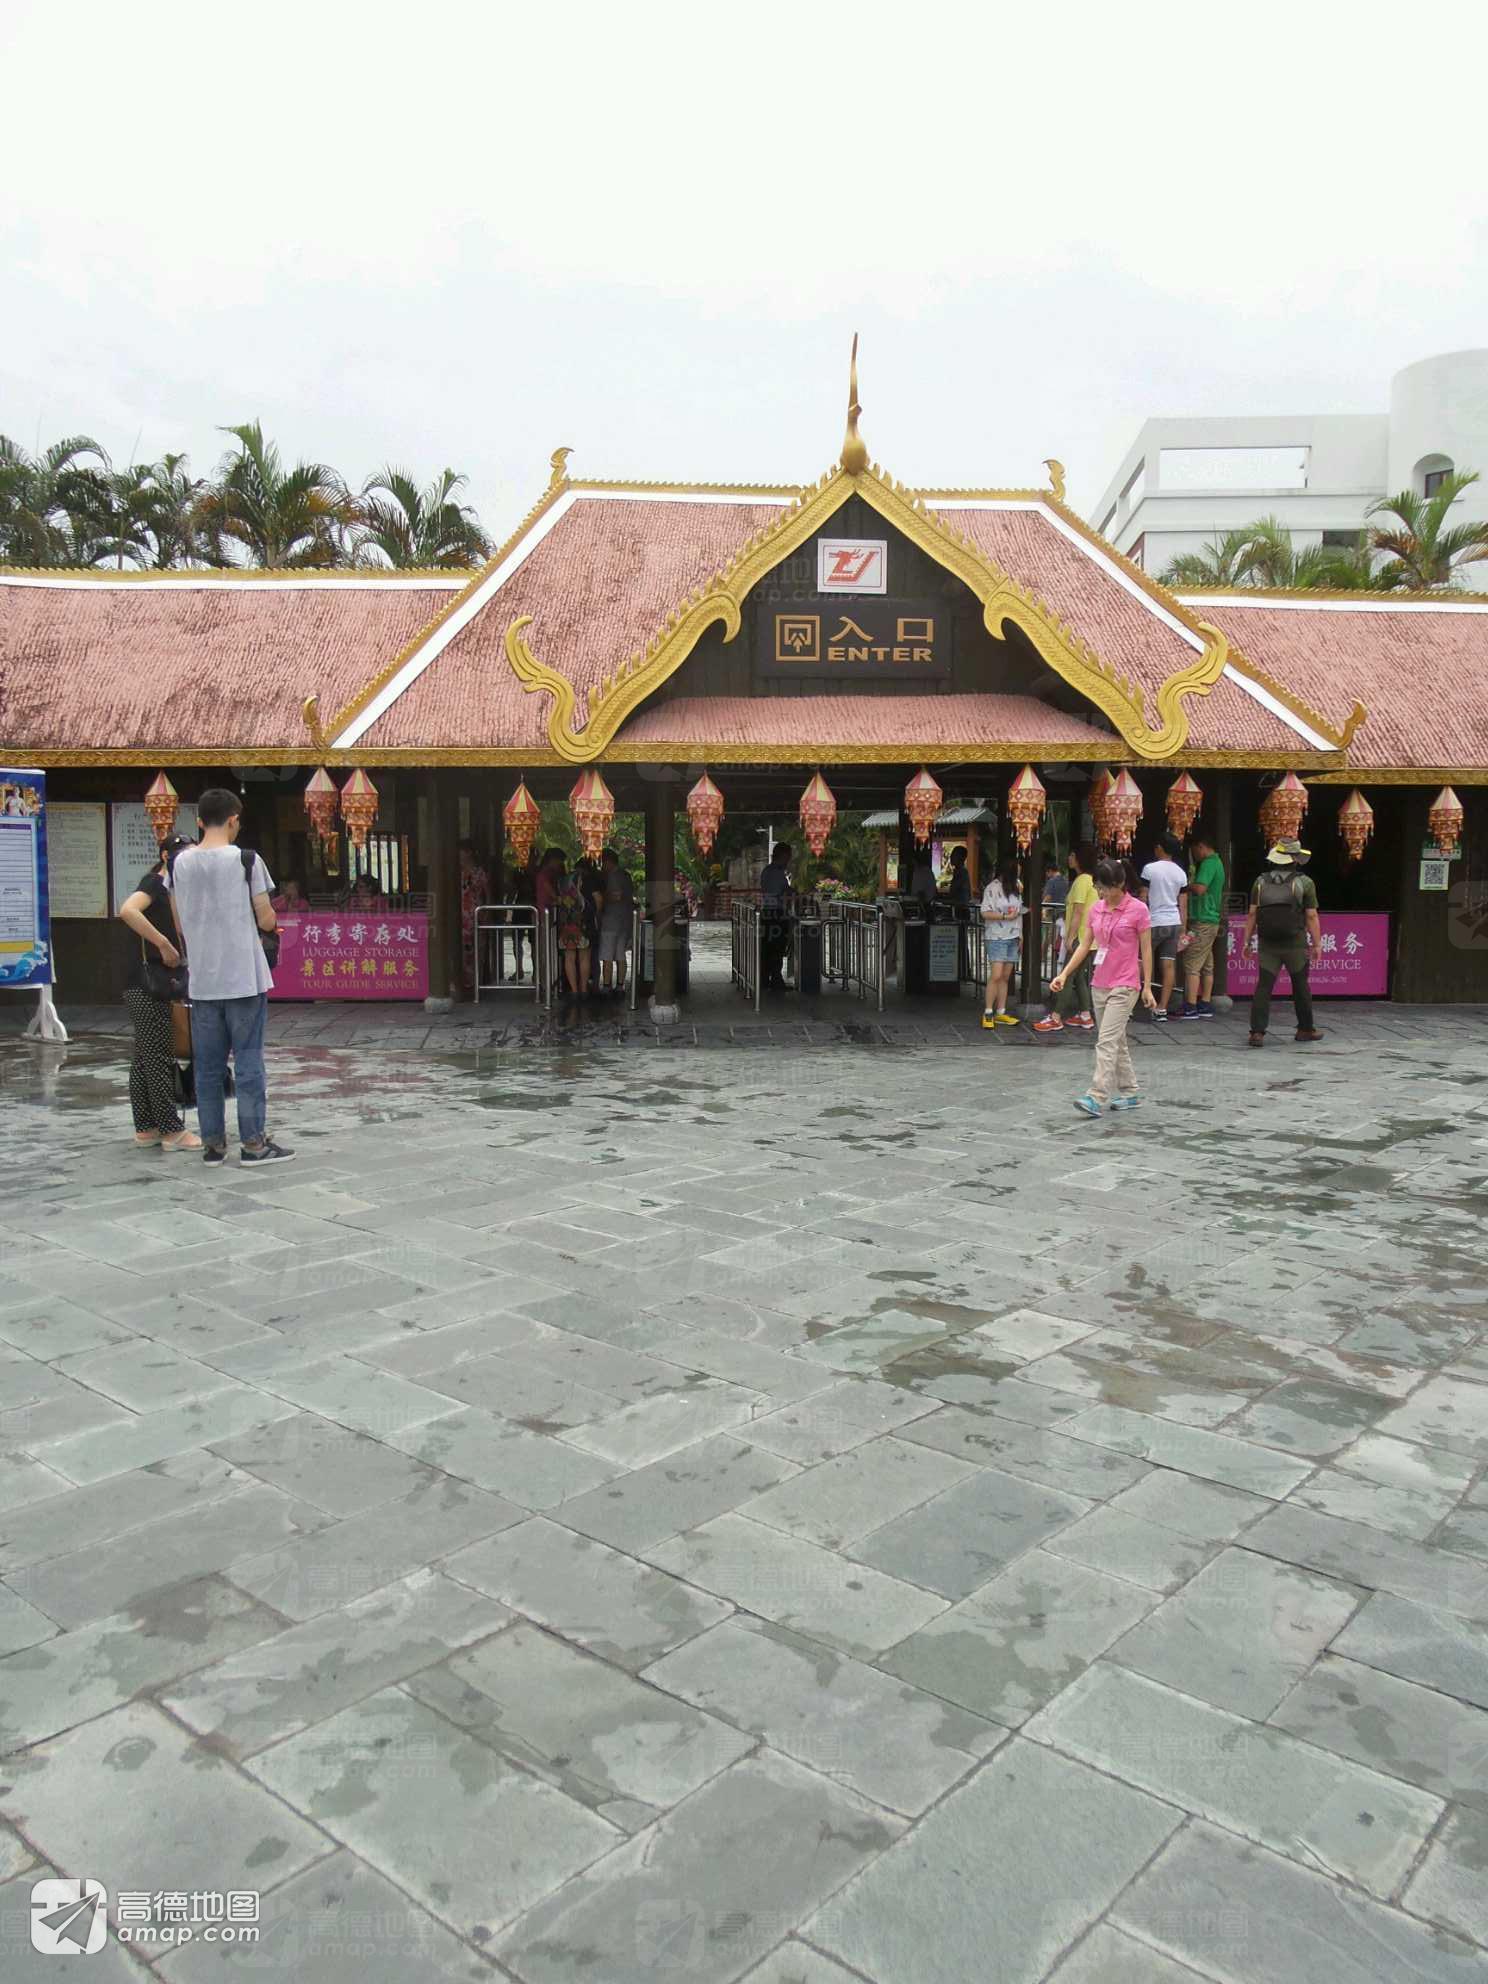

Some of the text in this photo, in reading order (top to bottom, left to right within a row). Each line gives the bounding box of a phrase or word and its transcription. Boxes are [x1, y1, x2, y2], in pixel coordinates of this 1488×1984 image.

[829, 616, 934, 642] 入口
[827, 647, 933, 662] ENTER
[302, 922, 419, 945] 行李寄存处
[302, 947, 420, 958] LUGGAGE STORAGE
[300, 958, 419, 978] 景区讲解服务
[1226, 959, 1257, 970] OUR
[303, 979, 419, 990] TOUR GUIDE SERVICE
